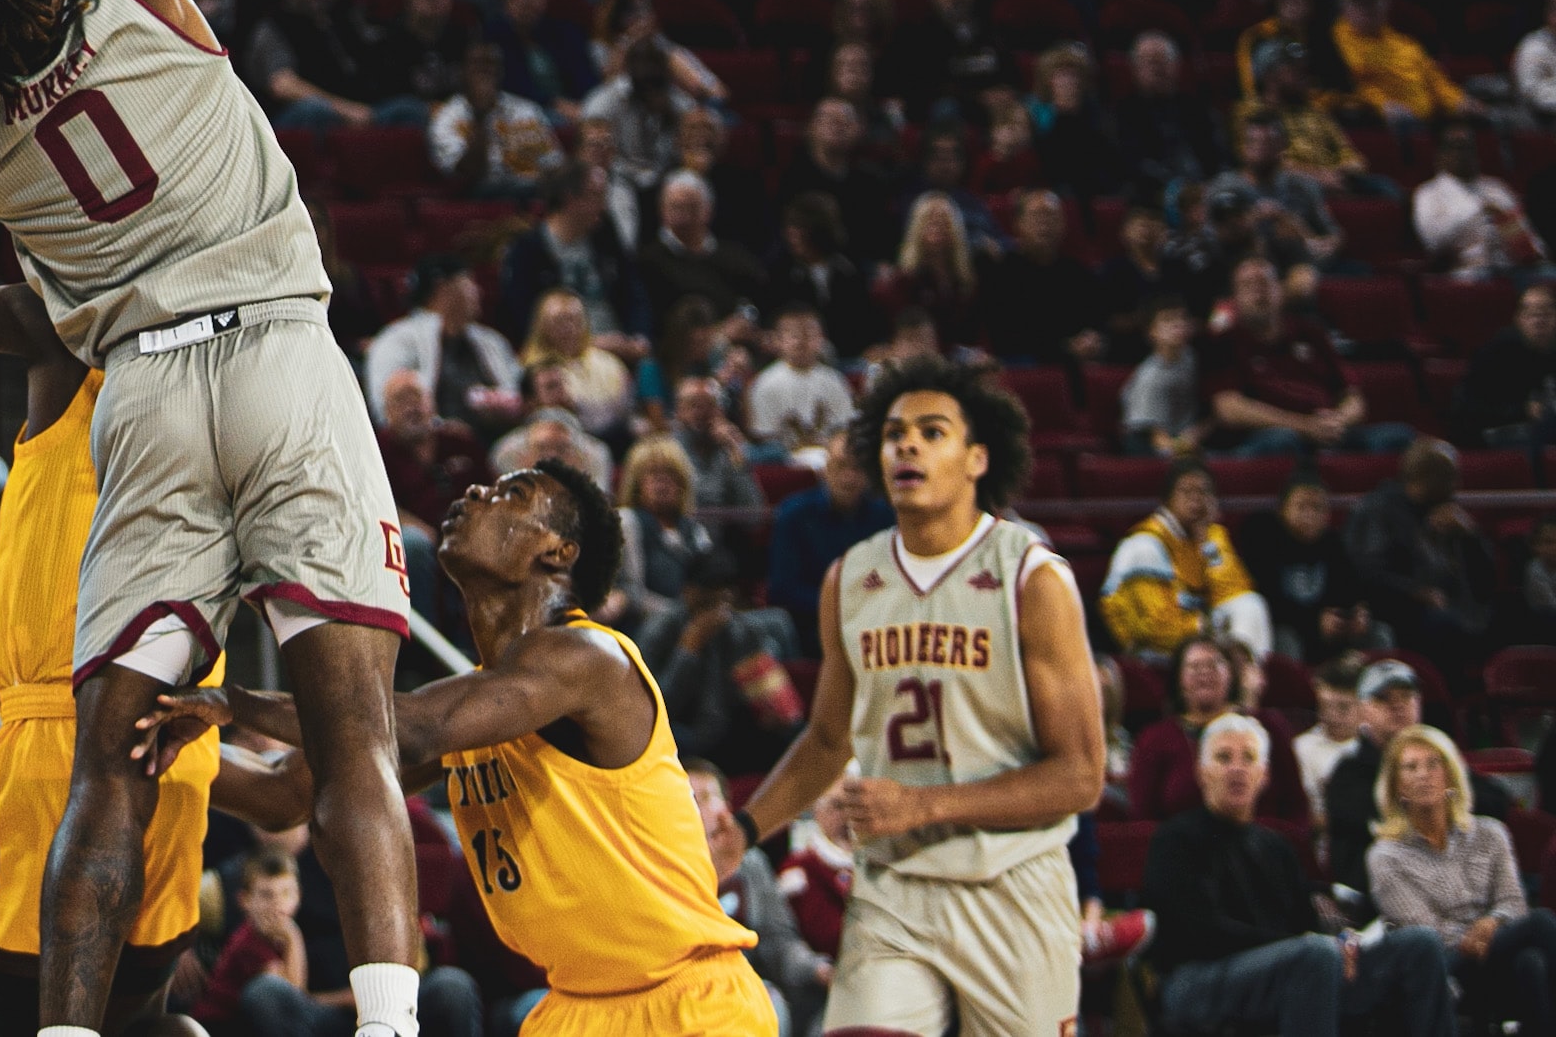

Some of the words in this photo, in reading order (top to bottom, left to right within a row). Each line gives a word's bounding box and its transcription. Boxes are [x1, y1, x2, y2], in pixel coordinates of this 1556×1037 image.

[34, 88, 159, 224] 0
[886, 675, 953, 768] 21
[471, 827, 522, 894] 15
